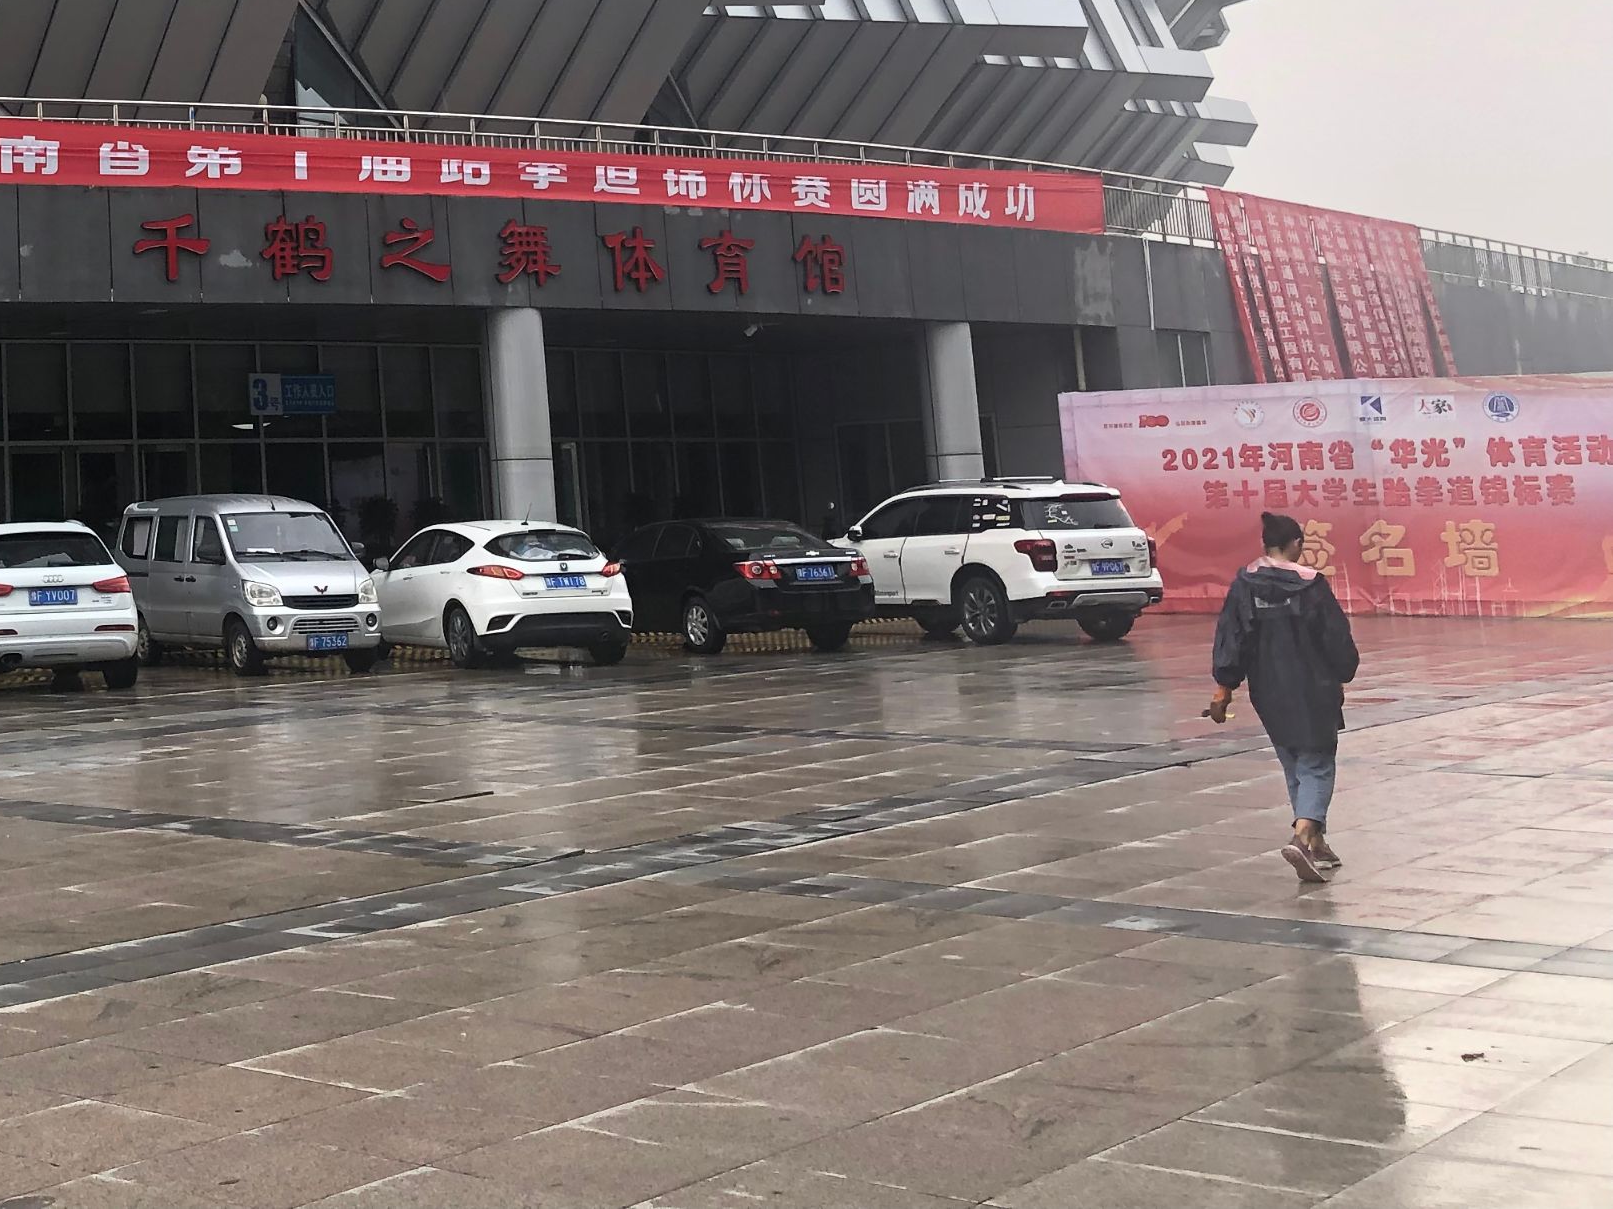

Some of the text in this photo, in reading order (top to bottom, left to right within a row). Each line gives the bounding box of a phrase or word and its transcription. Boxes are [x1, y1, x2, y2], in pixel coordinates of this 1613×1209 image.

[133, 214, 845, 295] 千鹤之舞体育馆
[1203, 474, 1575, 509] 第十届大学生跆拳道锦标赛
[1299, 519, 1499, 576] 签名墙
